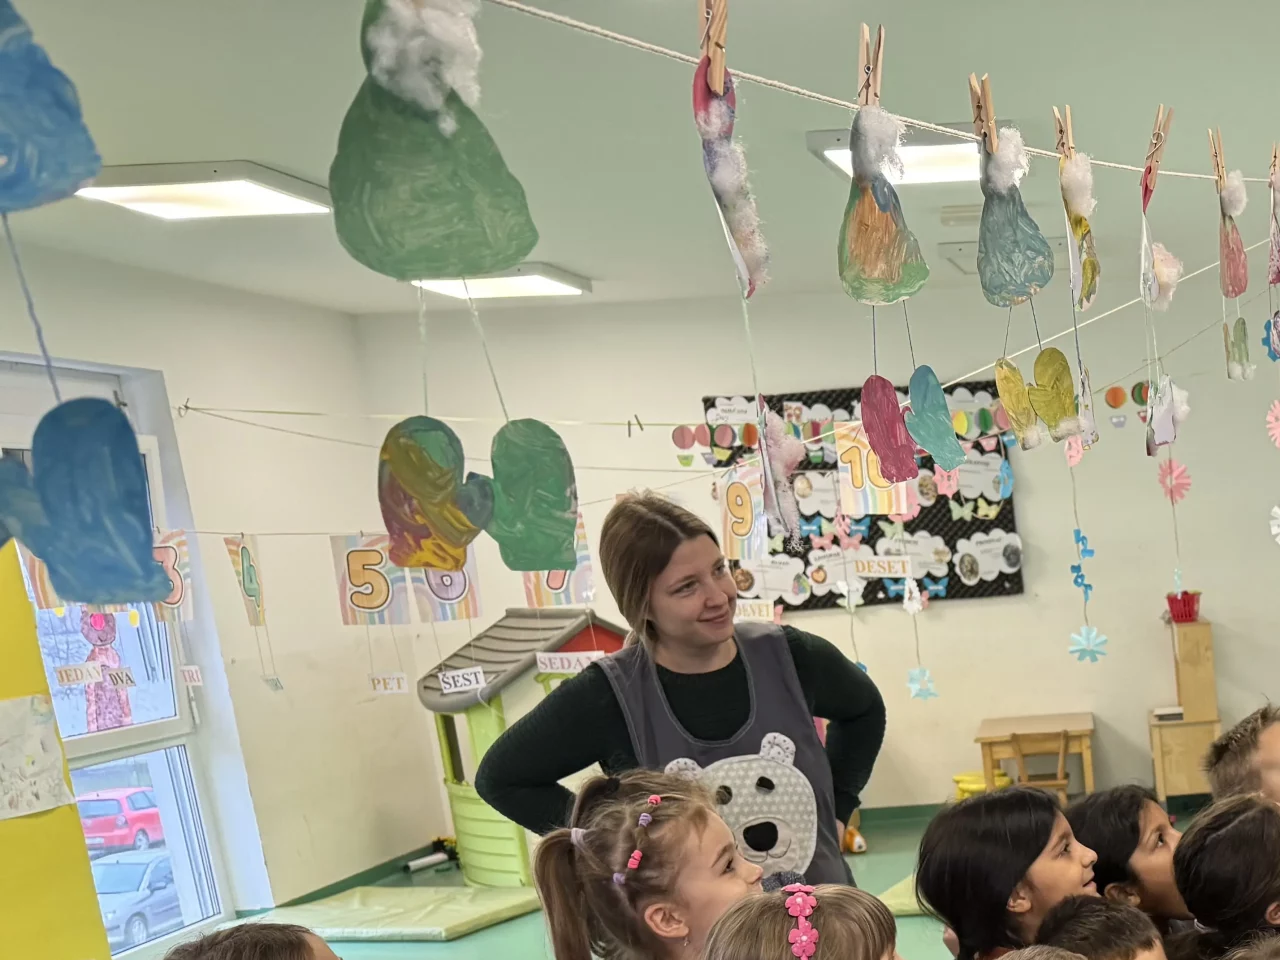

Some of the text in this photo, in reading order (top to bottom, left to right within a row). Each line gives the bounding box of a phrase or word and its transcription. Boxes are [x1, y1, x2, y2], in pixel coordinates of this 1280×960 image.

[726, 481, 753, 537] 9
[855, 559, 908, 574] DESET
[347, 549, 389, 609] 5
[109, 671, 134, 686] DVA
[180, 669, 201, 683] TRI
[371, 676, 405, 691] PET
[440, 671, 482, 690] ŠEST
